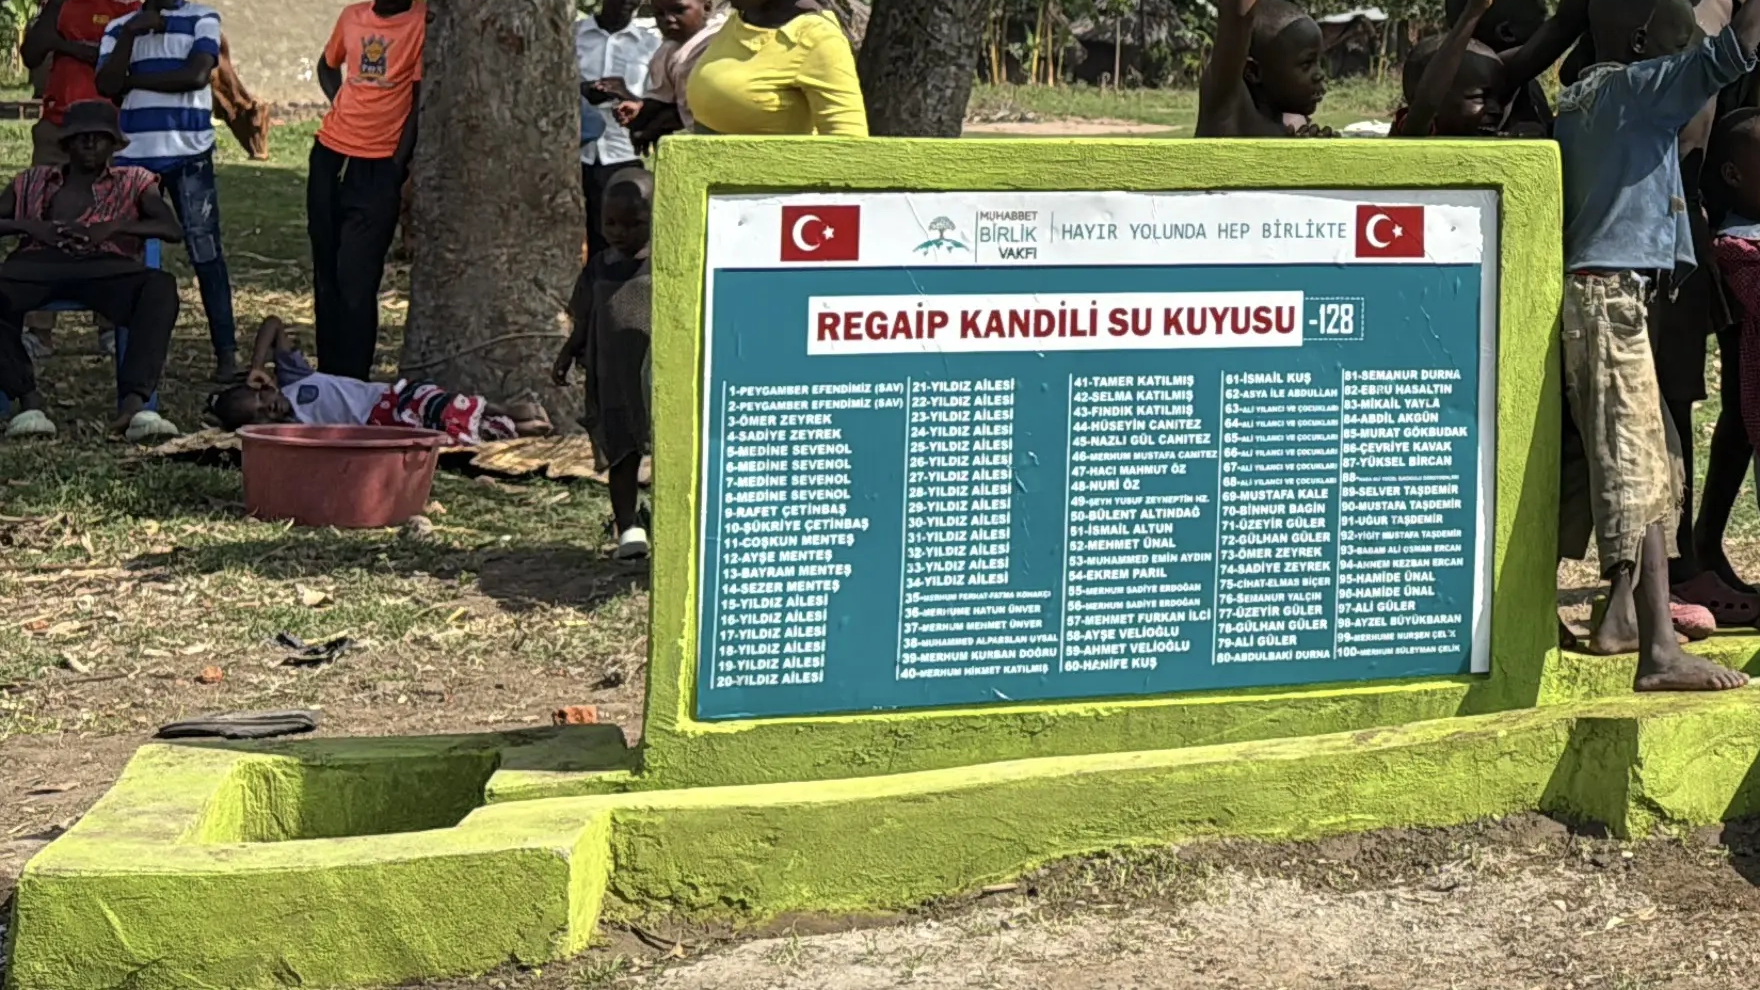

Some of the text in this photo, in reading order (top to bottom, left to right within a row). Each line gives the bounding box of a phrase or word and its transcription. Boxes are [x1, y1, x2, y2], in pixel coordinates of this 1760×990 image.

[980, 211, 1038, 221] MUHABBET
[980, 223, 1037, 242] BİRLİK
[1062, 218, 1347, 240] HAYIR YOLUNDA HEP BİRLİKTE
[999, 247, 1037, 259] VAKFI
[817, 302, 949, 341] REGAİP
[960, 300, 1098, 338] KANDİLİ
[1108, 307, 1152, 336] SU
[1164, 306, 1295, 335] KUYUSU
[1073, 375, 1194, 388] 41-TAMER KATILMIŞ
[1225, 370, 1311, 385] 61-İSMAİL KUŞ
[1420, 369, 1460, 380] DURNA
[729, 381, 904, 396] 1-PEYGAMBER EFENDİMİZ (SAV)
[912, 377, 1014, 392] 21-YILDIZ AİLESİ
[1343, 383, 1452, 395] 82-EBRU HASALTIN
[911, 392, 1014, 407] 22-YILDIZ AİLESİ
[1073, 390, 1193, 403] 42-SELMA KATILMIŞ
[1225, 386, 1337, 399] 62-ASYA İLE ABDULLAH
[728, 396, 904, 411] 2-PEYGAMBER EFENDİMİZ (SAV)
[1342, 396, 1440, 409] 83-MİKAİL YAYLA
[911, 407, 1013, 422] 23-YILDIZ AİLESİ
[1073, 404, 1193, 417] 43-FINDIK KATILMIŞ
[1342, 410, 1438, 424] 84-ABDİL AKGÜN
[727, 413, 831, 426] 3-ÖMER ZEYREK
[726, 427, 841, 441] 4-SADİYE ZEYREK
[910, 422, 1012, 437] 24-YILDIZ AİLESİ
[1342, 424, 1467, 438] 85-MURAT GÖKBUDAK
[1072, 435, 1126, 446] 45-NAZLI
[1130, 432, 1155, 445] GÜL
[1412, 441, 1451, 452] KAVAK
[1341, 453, 1452, 467] 87-YÜKSEL BİRCAN
[1071, 461, 1186, 476] 47-HACI MAHMUT ÖZ
[725, 473, 851, 487] 7-MEDİNE SEVENOL
[1070, 477, 1140, 491] 48-NURİ ÖZ
[1222, 488, 1328, 501] 69-MUSTAFA KALE
[1340, 482, 1458, 498] 89-SELVER TAŞDEMİR
[724, 501, 846, 518] 9-RAFET ÇETİNBAŞ
[1222, 501, 1285, 515] 70-BİNNUR
[1340, 496, 1461, 512] 90-MUSTAFA TAŞDEMİR
[908, 512, 1010, 527] 30-YILDIZ AİLESİ
[1070, 505, 1200, 521] 50-BÜLENT ALTINDAĞ
[1340, 511, 1443, 527] 91-UĞUR TAŞDEMİR
[804, 516, 869, 532] ÇETİNBAŞ
[1070, 522, 1173, 536] 51-İSMAİL ALTUN
[1221, 514, 1325, 530] 71-ÜZEYİR GÜLER
[724, 533, 854, 550] 11-COŞKUN MENTEŞ
[907, 527, 1010, 542] 31-YILDIZ AİLESİ
[1221, 529, 1330, 545] 72-GÜLHAN GÜLER
[1069, 535, 1176, 551] 52-MEHMET ÜNAL
[723, 549, 832, 565] 12-AYŞE MENTEŞ
[1221, 545, 1322, 560] 73-ÖMER ZEYREK
[723, 564, 851, 578] 13-BAYRAM MENTEŞ
[1068, 568, 1129, 580] 54-EKREM
[1220, 560, 1330, 574] 74-SADİYE ZEYREK
[1301, 573, 1330, 588] BİÇER
[1338, 569, 1435, 583] 95-HAMİDE ÜNAL
[722, 580, 840, 594] 14-SEZER MENTEŞ
[721, 593, 828, 609] 15-YILDIZ AİLESİ
[1219, 590, 1321, 604] 76-SEMANUR YALÇIN
[1007, 601, 1040, 613] ÜNVER
[1337, 598, 1415, 612] 97-ALİ GÜLER
[965, 619, 1007, 630] MEHMET
[1009, 616, 1042, 628] ÜNVER
[1066, 608, 1210, 626] 57-MEHMET FURKAN İLCİ
[1066, 624, 1179, 643] 58-AYŞE VELİOĞLU
[1217, 632, 1297, 648] 79-ALİ GÜLER
[1065, 638, 1190, 656] 59-AHMET VELİOĞLU
[1295, 648, 1330, 659] DURNA
[1131, 657, 1157, 670] KUŞ
[781, 669, 823, 684] AİLESİ
